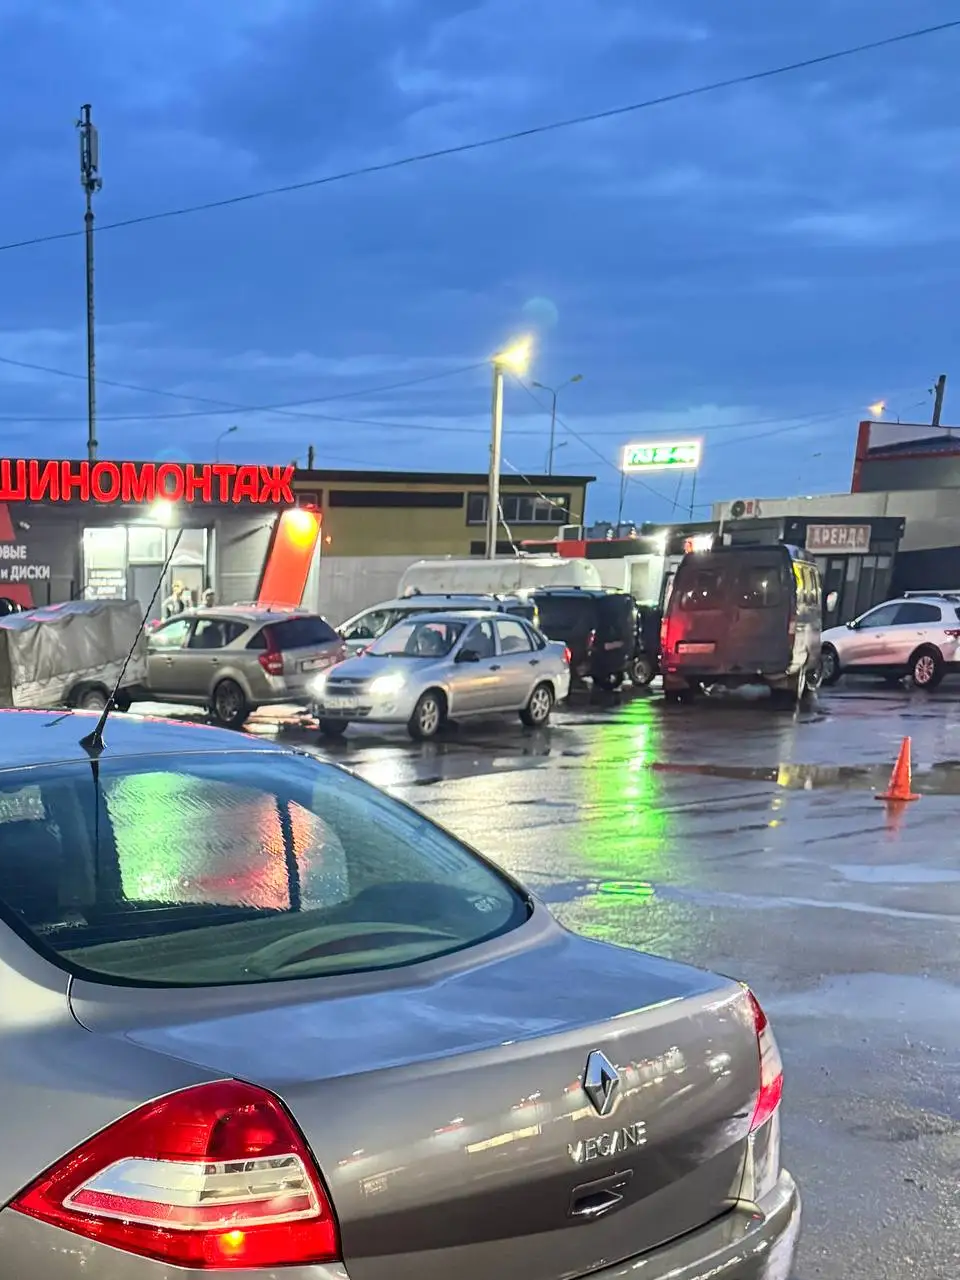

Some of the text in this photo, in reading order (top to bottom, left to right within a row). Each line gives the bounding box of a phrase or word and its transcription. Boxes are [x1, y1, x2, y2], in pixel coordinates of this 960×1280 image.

[813, 527, 865, 546] АРЕНДА
[1, 568, 8, 578] и
[10, 565, 50, 582] ДИСКИ
[567, 1121, 647, 1163] MEGANE
